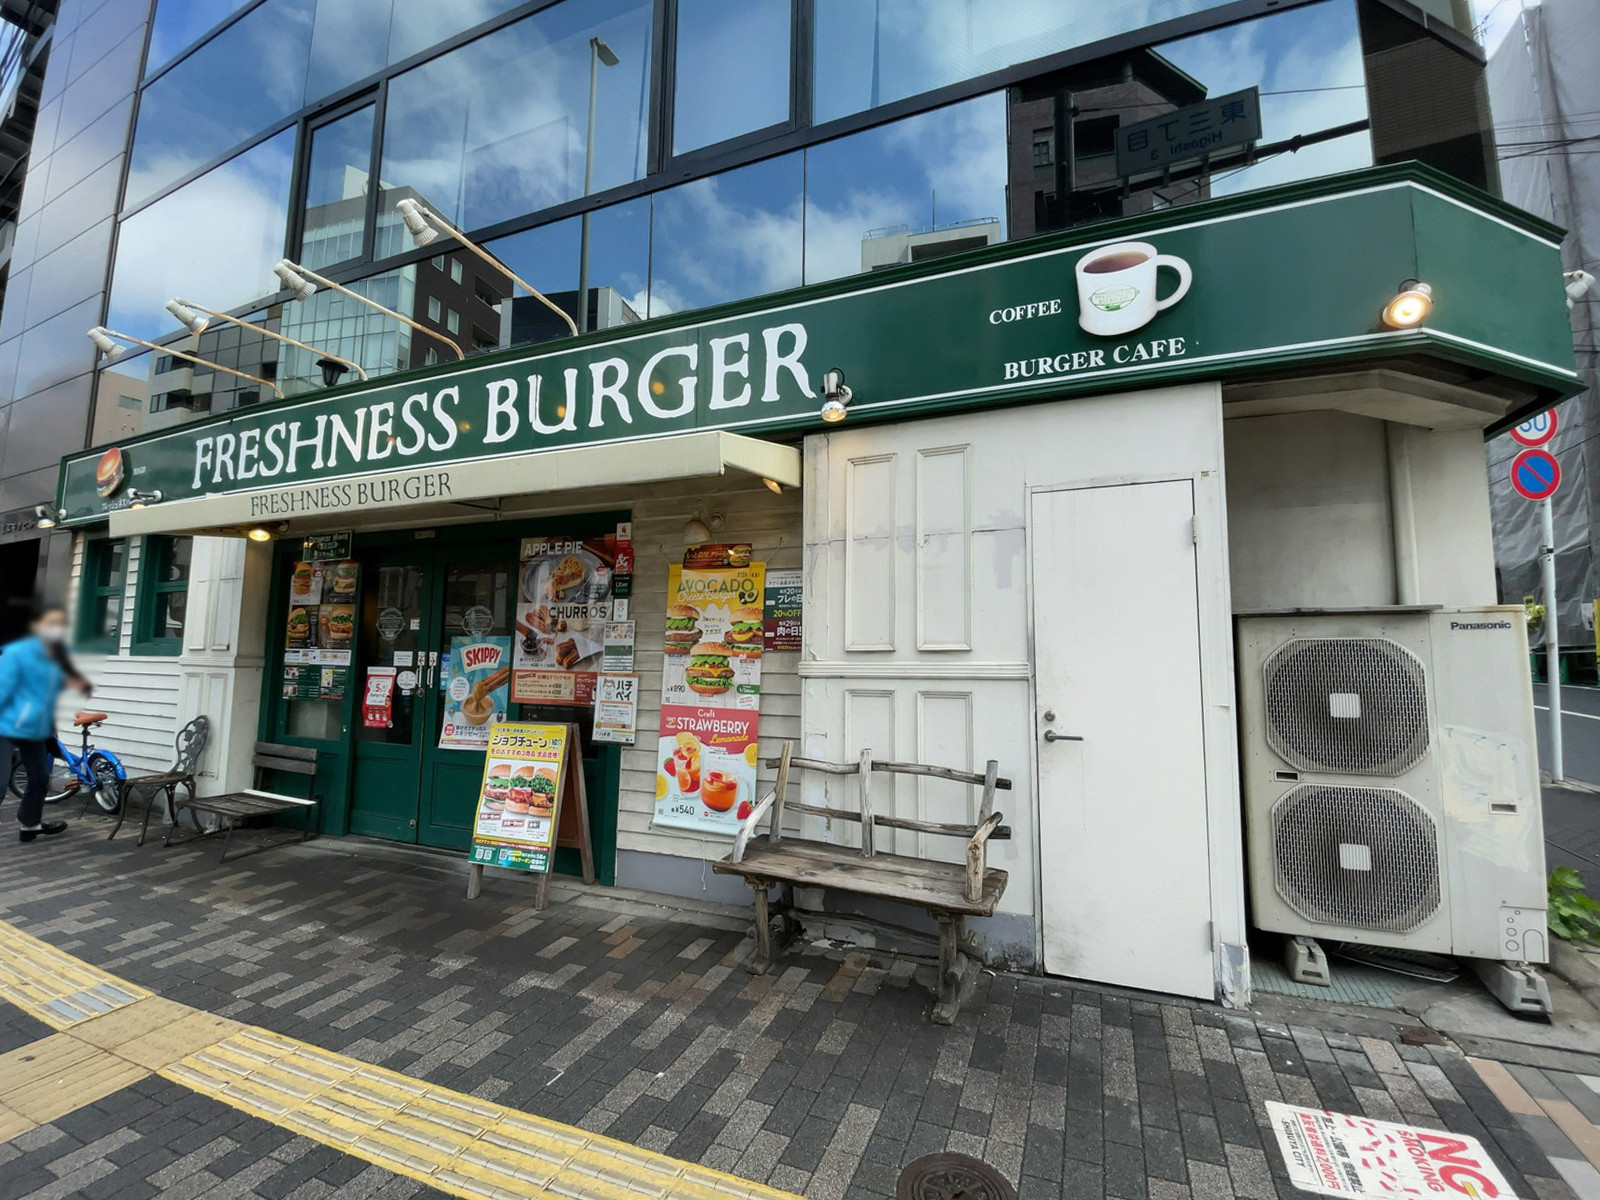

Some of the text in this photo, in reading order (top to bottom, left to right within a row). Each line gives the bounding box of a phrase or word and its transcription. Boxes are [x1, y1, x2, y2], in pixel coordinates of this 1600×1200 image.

[989, 299, 1062, 325] COFFEE
[1003, 337, 1186, 380] BURGER CAFE
[192, 323, 817, 490] FRESHNESS BURGER
[250, 472, 453, 516] FRESHNESS BURGER
[524, 541, 583, 556] APPLE PIE
[677, 579, 754, 593] AVOCADO
[549, 606, 608, 619] CHURROS
[1450, 621, 1512, 631] Panasonic
[465, 647, 501, 667] SKIPPY
[616, 680, 633, 690] ハチ
[697, 709, 716, 718] Craft
[676, 717, 750, 735] STRAWBERRY
[709, 733, 749, 745] Lemonade
[1281, 1119, 1299, 1150] SHIBUYA
[1293, 1151, 1306, 1168] CITY
[1397, 1130, 1445, 1192] SMOKING
[1416, 1133, 1499, 1199] NG
